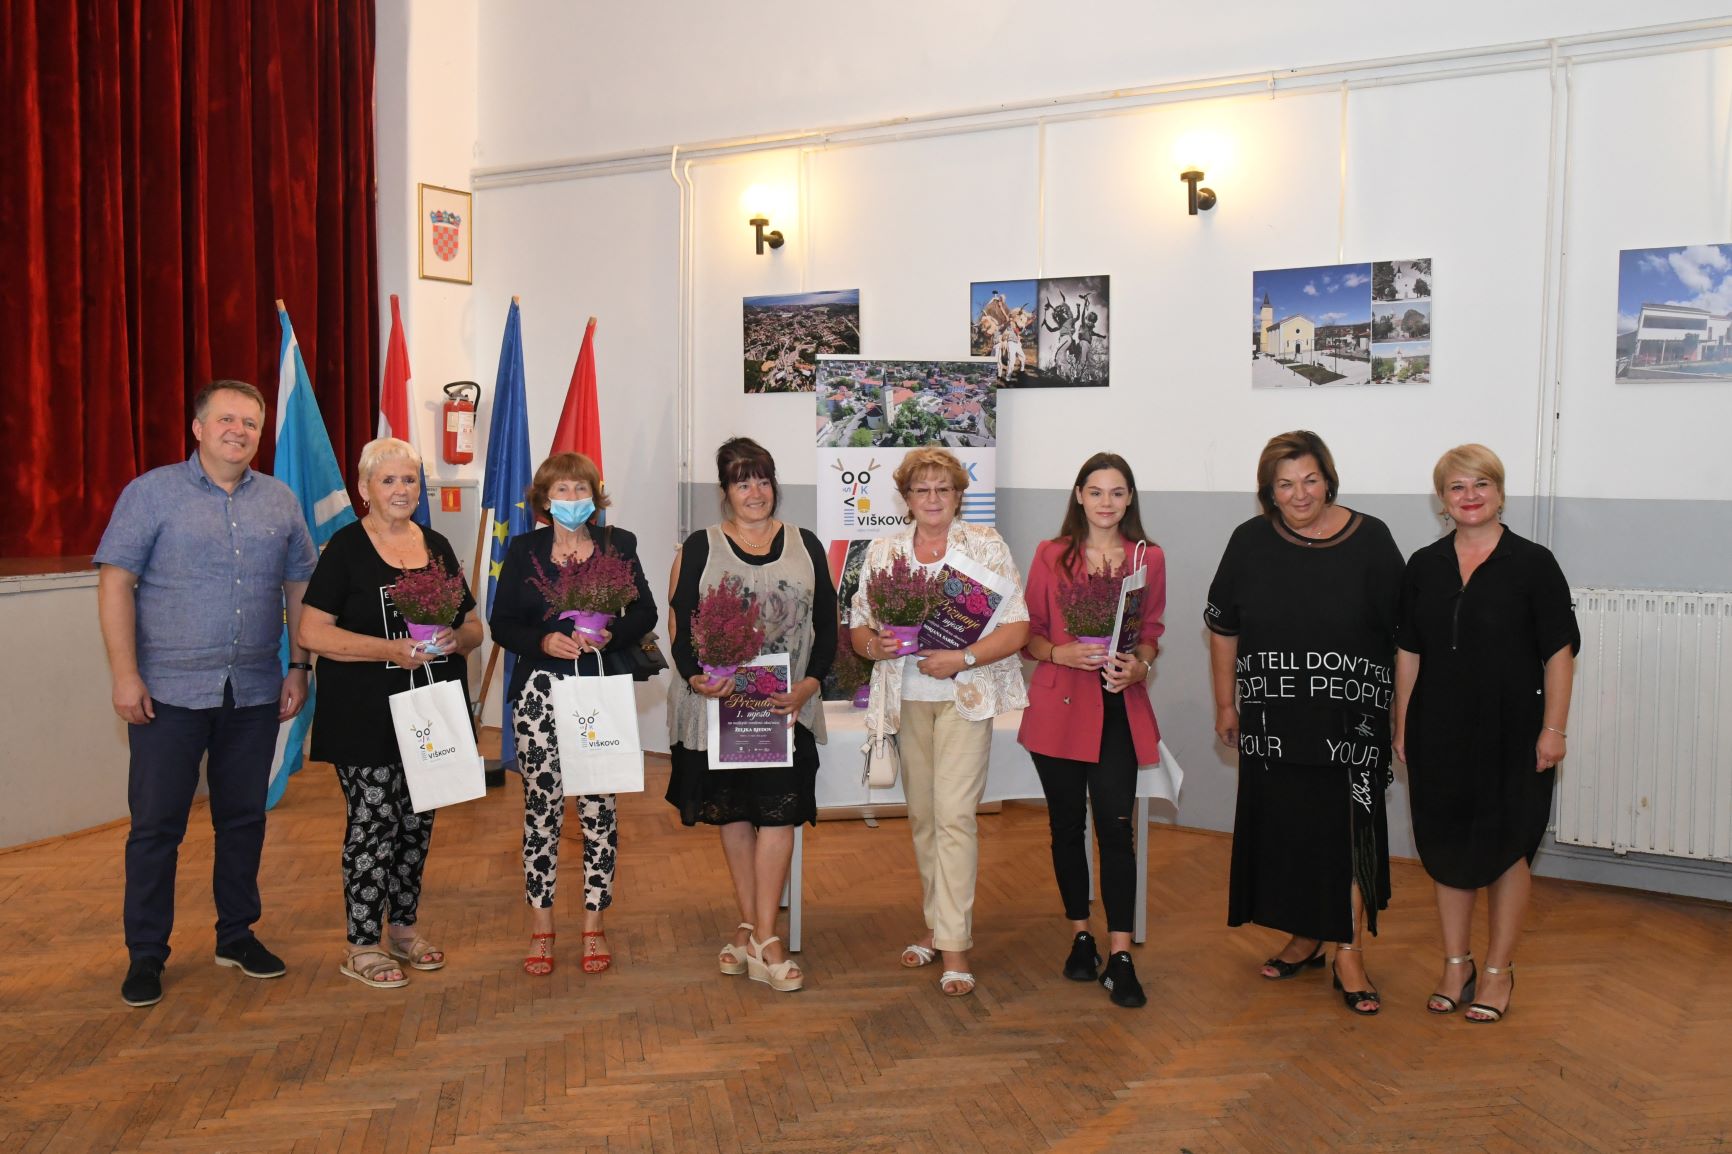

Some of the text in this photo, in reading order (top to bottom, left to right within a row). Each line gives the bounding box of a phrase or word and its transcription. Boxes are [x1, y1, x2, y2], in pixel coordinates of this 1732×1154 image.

[857, 514, 912, 526] VIŠKOVO
[1258, 652, 1300, 670] TELL
[1306, 652, 1369, 676] DON'T
[1310, 676, 1394, 710] PEOPLE
[589, 739, 620, 747] VIŠKOVO
[428, 746, 456, 759] VIŠKOVO
[1327, 738, 1380, 768] YOUR
